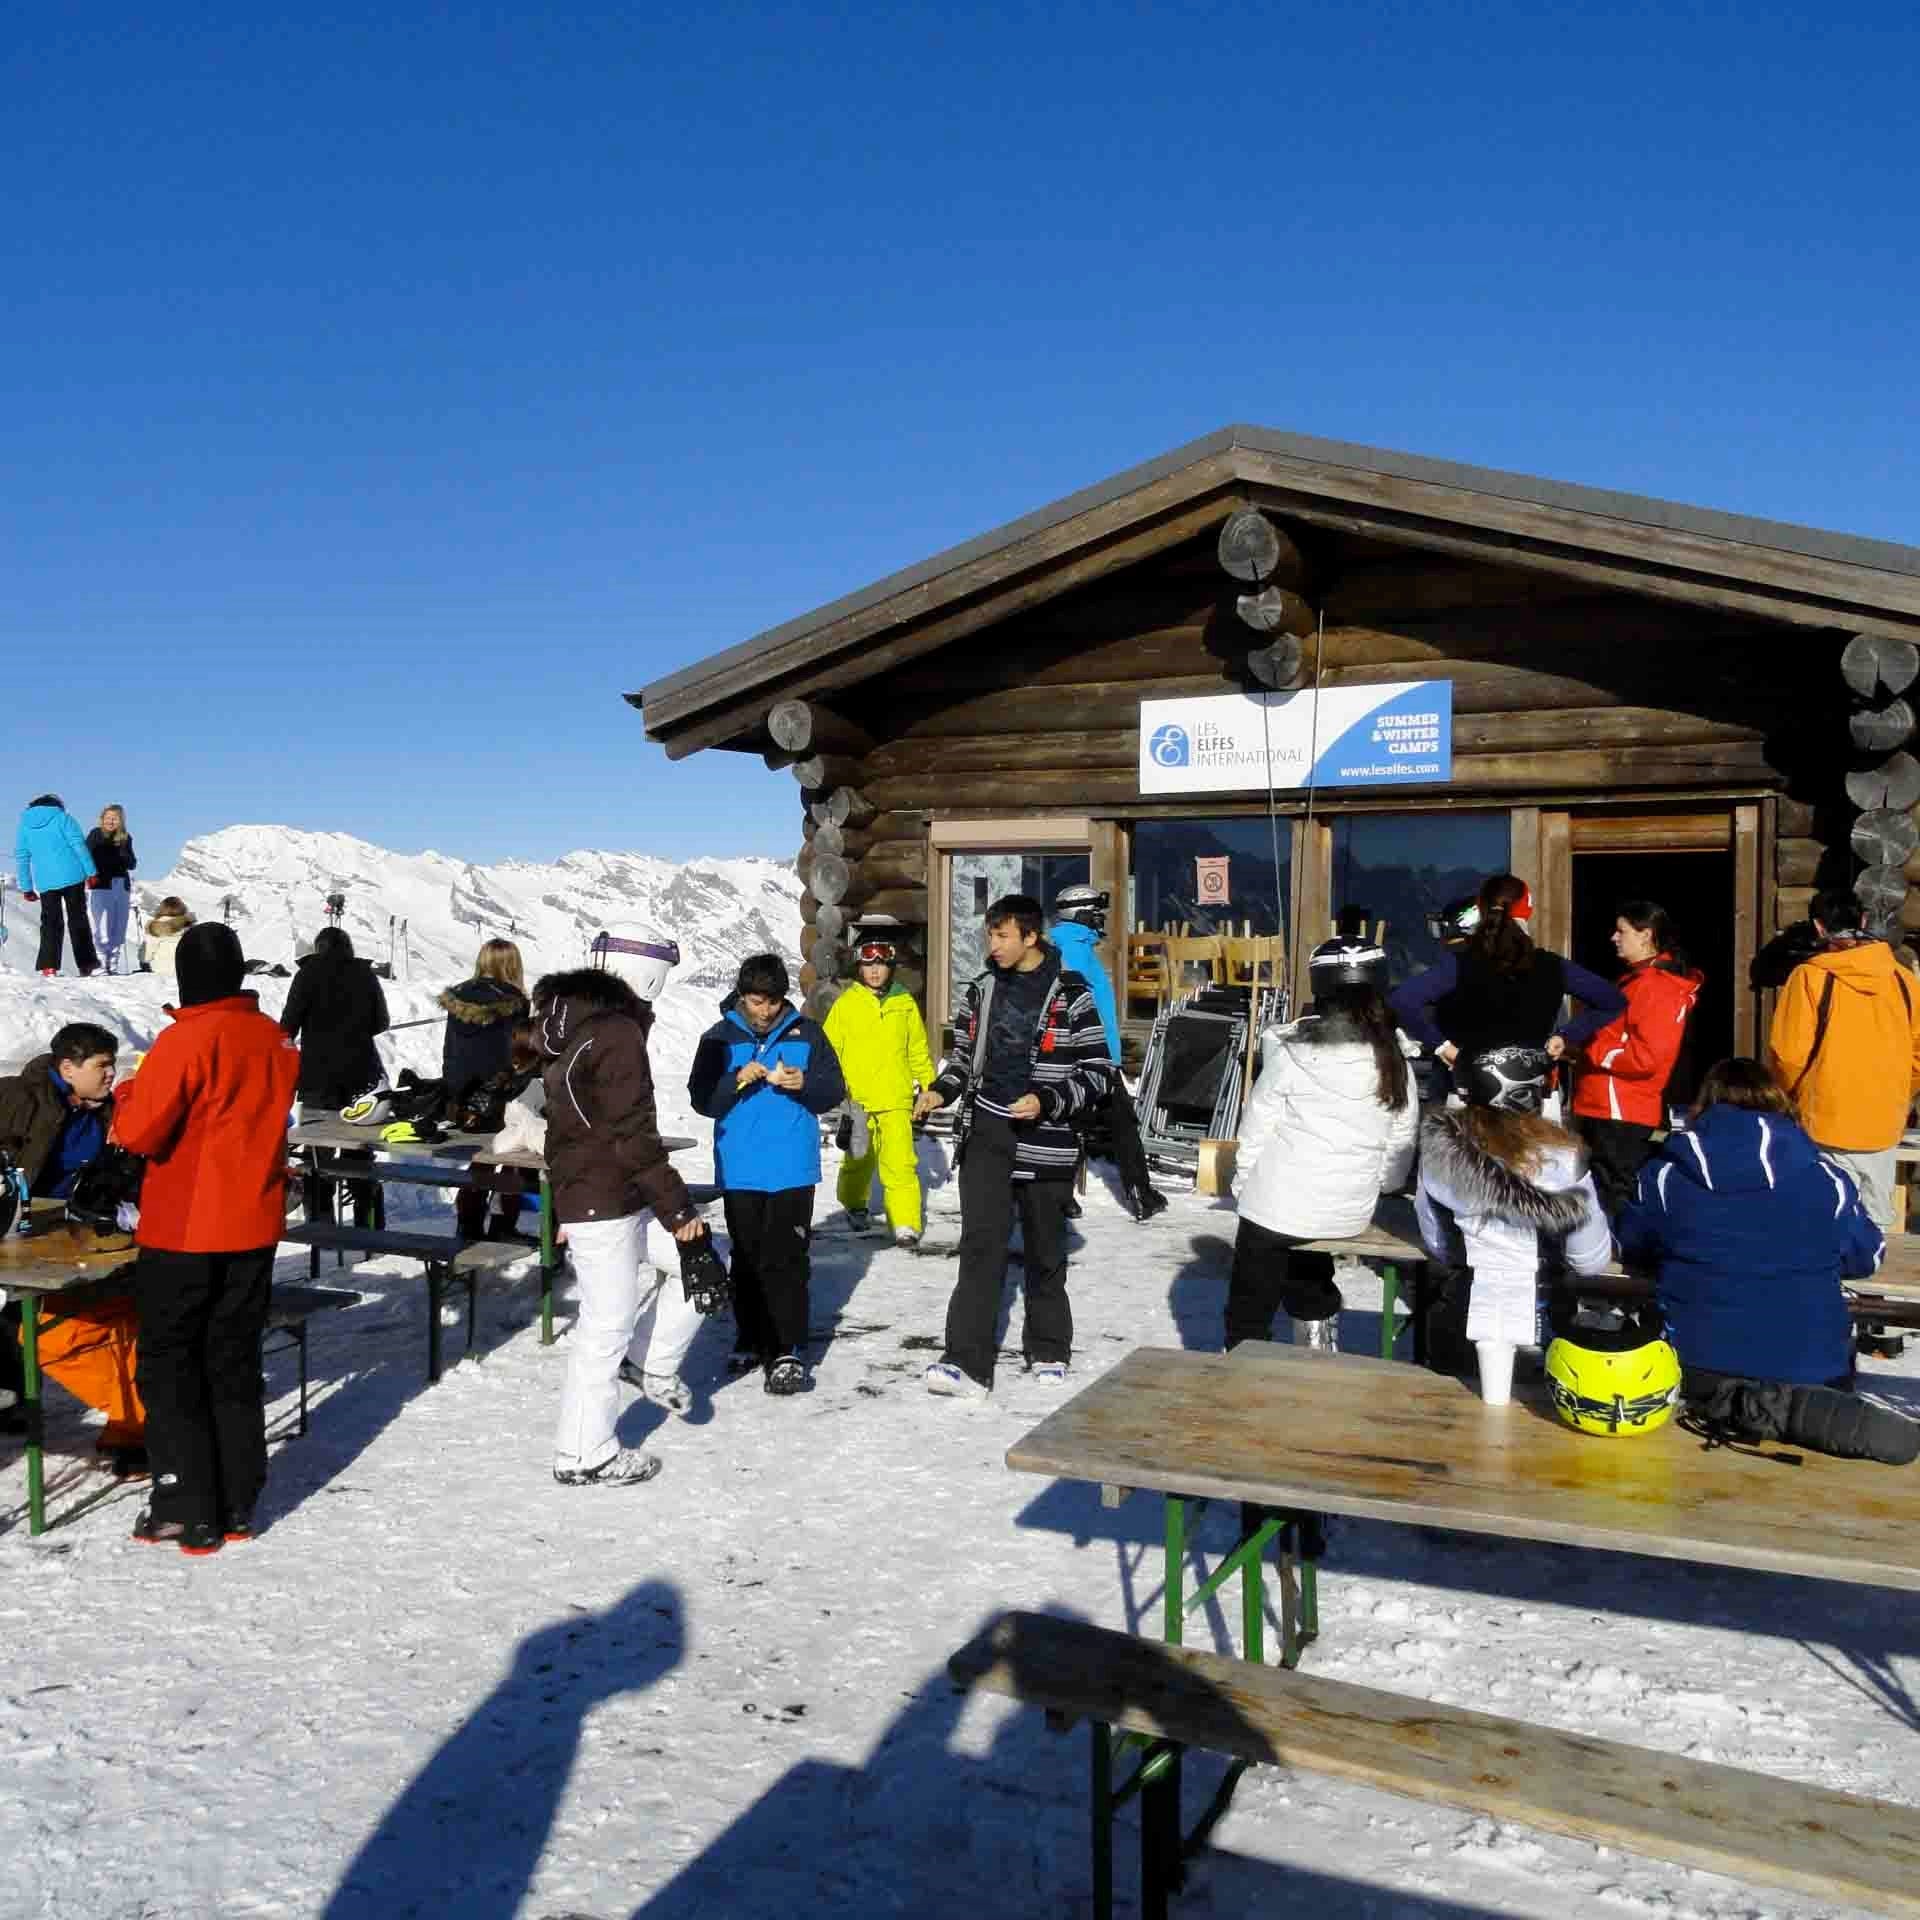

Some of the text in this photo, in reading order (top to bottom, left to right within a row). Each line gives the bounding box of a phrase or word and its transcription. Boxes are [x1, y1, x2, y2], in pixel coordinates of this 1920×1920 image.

[1197, 720, 1219, 737] LES
[1376, 713, 1440, 728] SUMMER
[1197, 736, 1235, 752] ELFES
[1388, 741, 1440, 754] CAMPS
[1197, 748, 1303, 768] INTERNATIONAL
